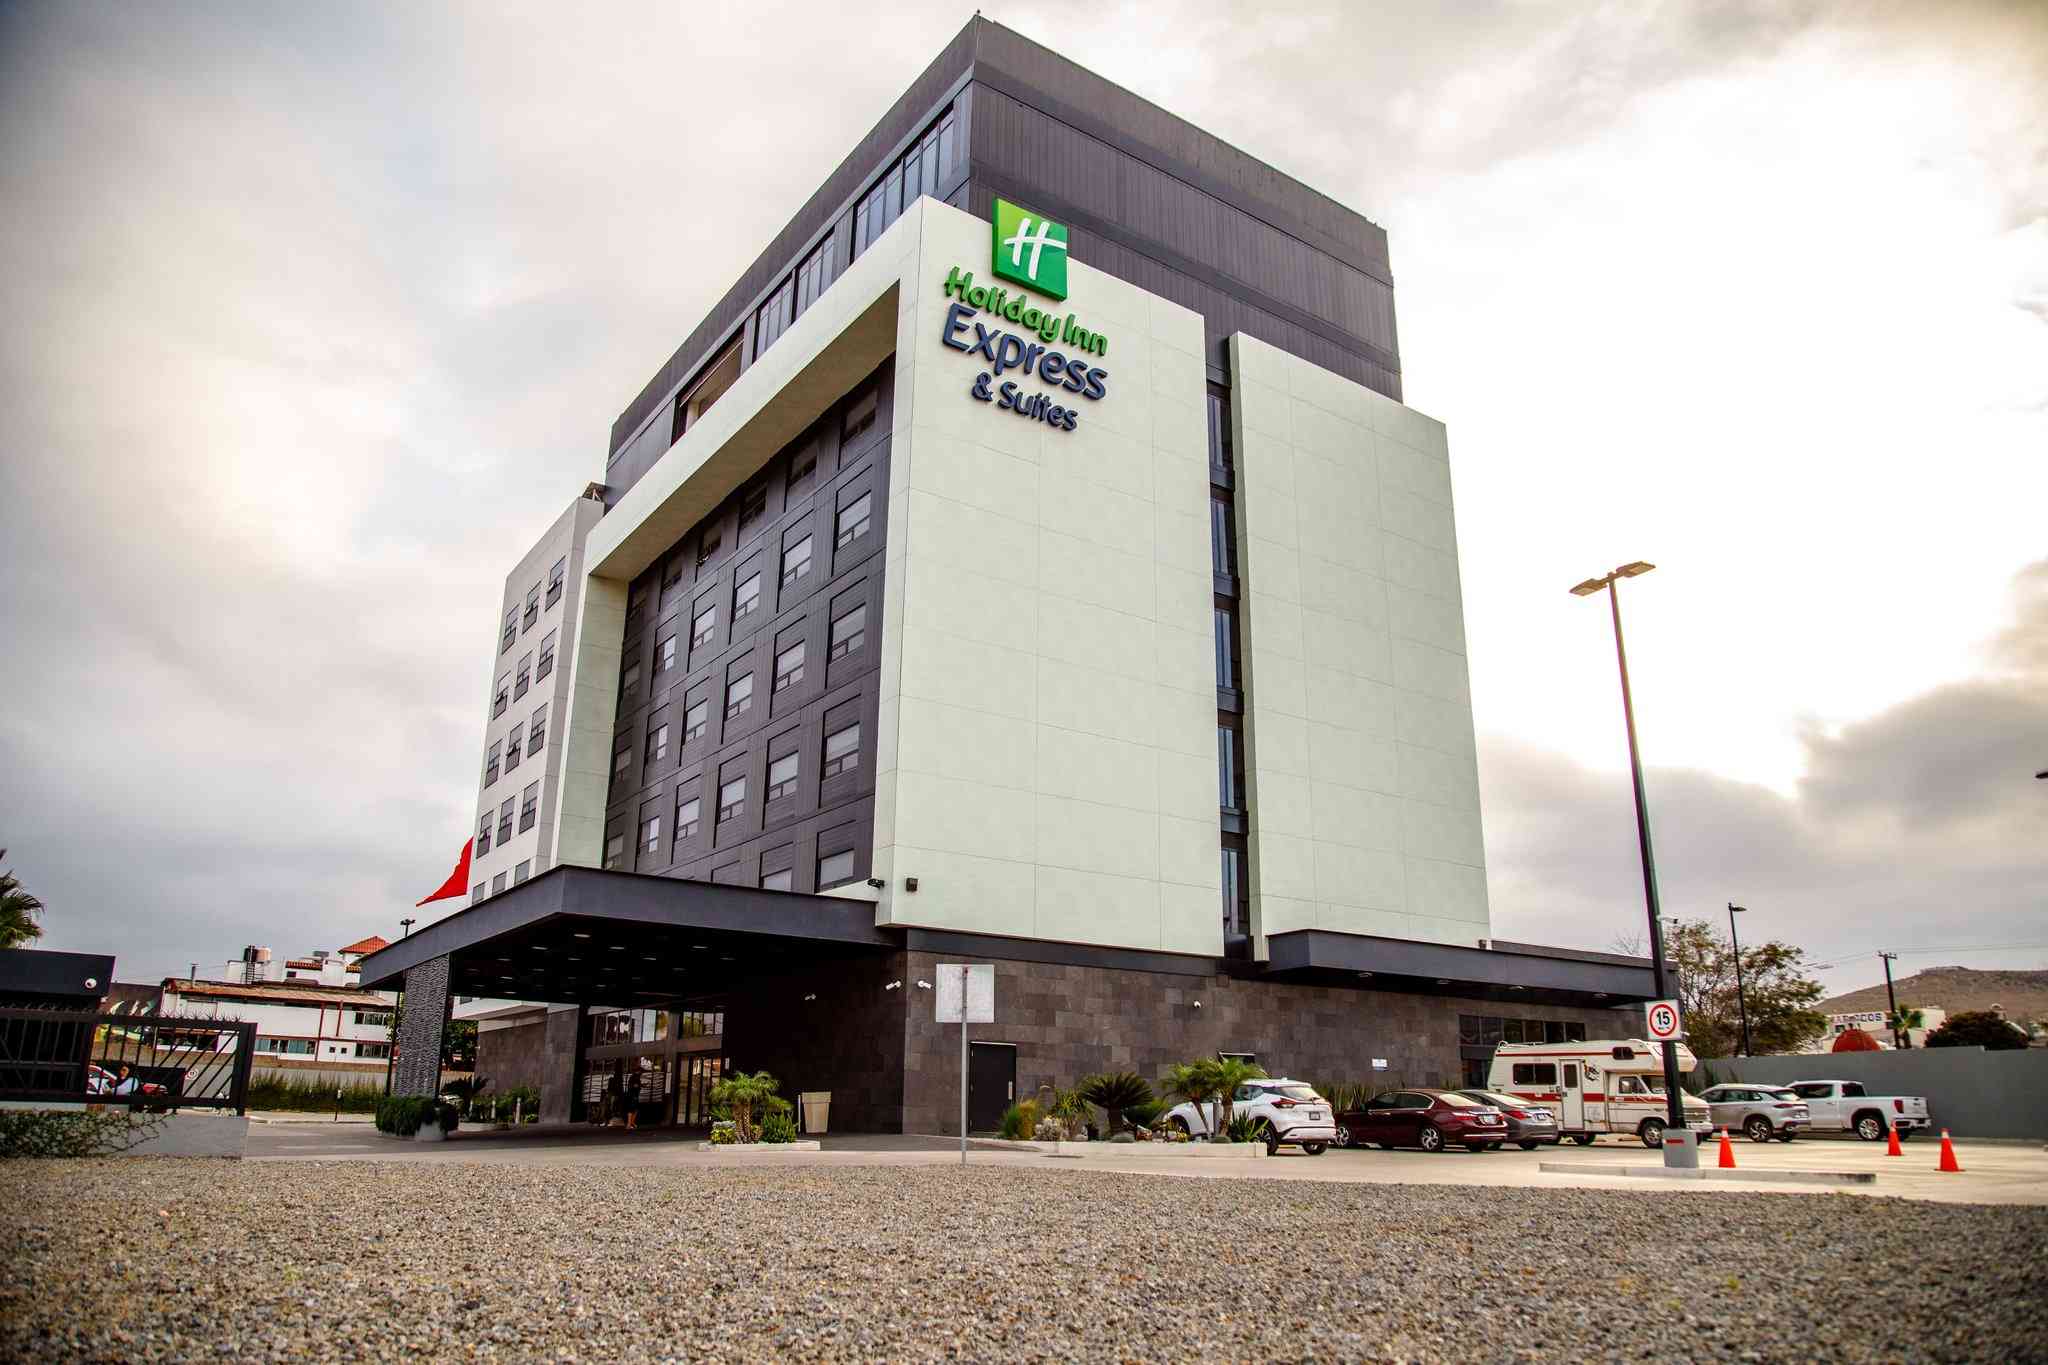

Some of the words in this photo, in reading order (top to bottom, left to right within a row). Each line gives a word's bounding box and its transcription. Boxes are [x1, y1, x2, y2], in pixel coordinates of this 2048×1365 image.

[944, 266, 1061, 343] Holiday
[1064, 313, 1108, 356] Inn
[942, 303, 1108, 400] Express
[971, 372, 993, 402] &
[998, 381, 1078, 431] Suites
[1656, 1010, 1671, 1025] 15
